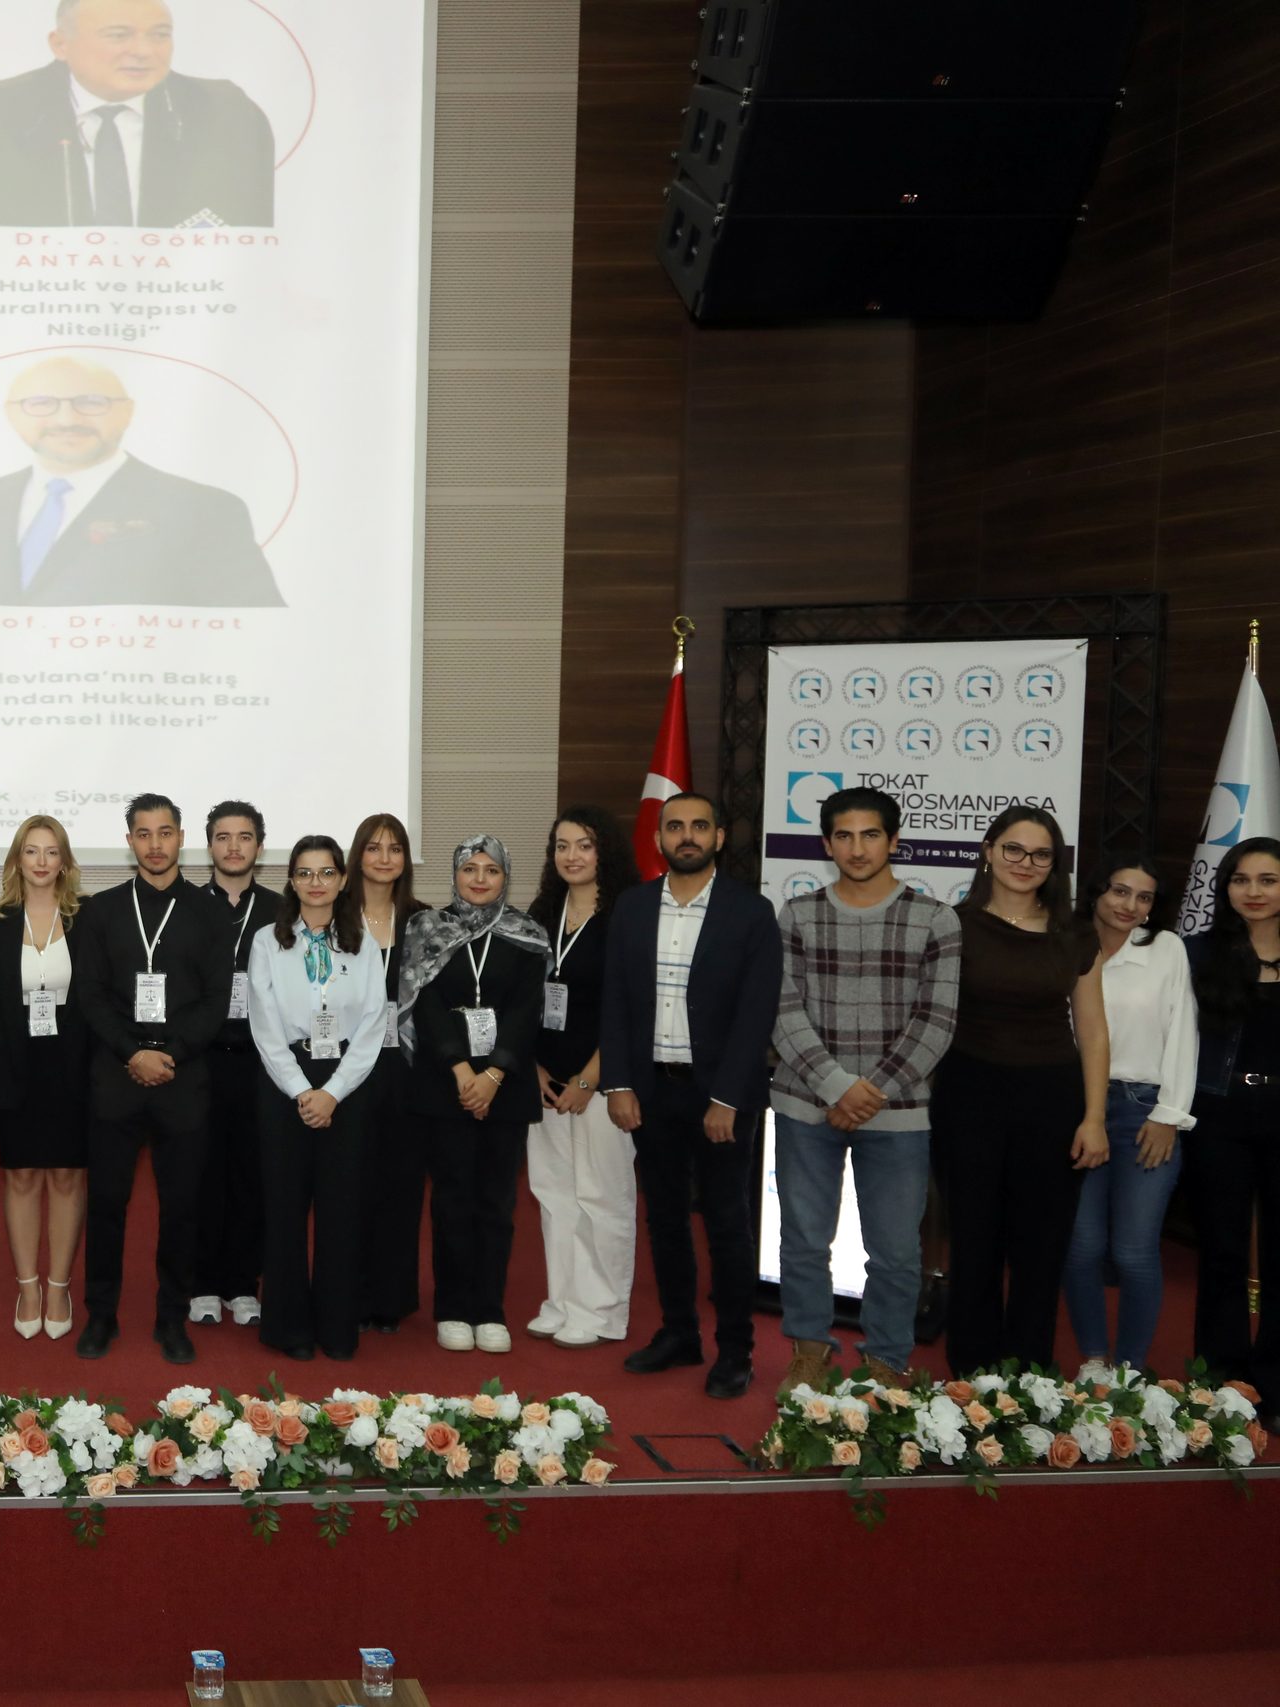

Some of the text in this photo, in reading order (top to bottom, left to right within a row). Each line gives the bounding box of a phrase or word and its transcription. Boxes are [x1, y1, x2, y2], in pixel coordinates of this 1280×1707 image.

[15, 231, 64, 247] Dr.
[85, 231, 120, 247] O.
[140, 231, 279, 248] Gökhan
[15, 253, 172, 270] ANTALYA
[95, 280, 128, 294] ve
[136, 278, 225, 295] Hukuk
[109, 302, 197, 320] Yapısı
[205, 302, 238, 316] ve
[69, 614, 116, 629] Dr.
[137, 614, 244, 631] Murat
[48, 635, 158, 650] TOPUZ
[163, 671, 239, 689] Bakış
[82, 691, 205, 707] Hukukun
[214, 693, 271, 707] Bazı
[857, 772, 929, 790] TOKAT
[54, 789, 135, 806] Siyase
